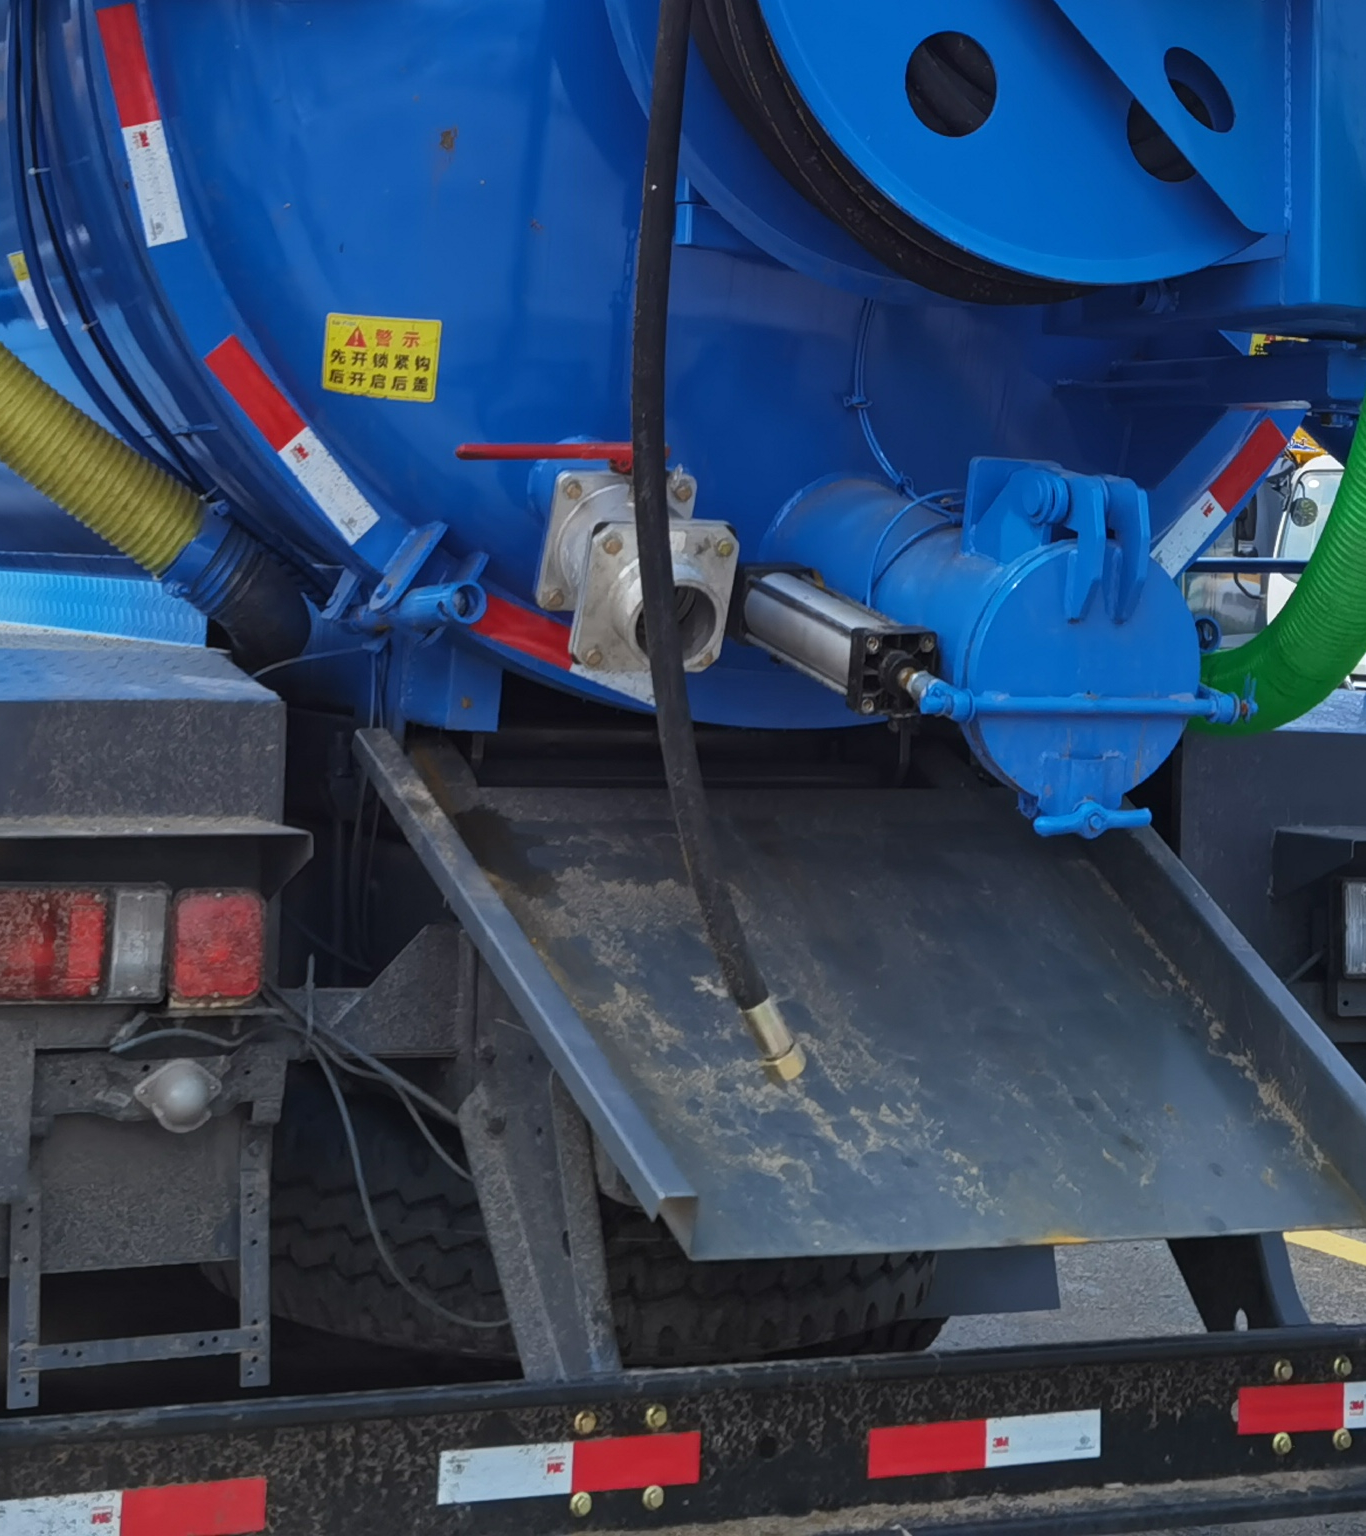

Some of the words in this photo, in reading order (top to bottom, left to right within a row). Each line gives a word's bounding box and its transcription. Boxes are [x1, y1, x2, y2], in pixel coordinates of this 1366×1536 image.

[375, 328, 420, 348] 警示
[330, 349, 431, 372] 先开锁紧钩
[328, 369, 429, 392] 后开启后盖
[992, 1436, 1009, 1448] 3M
